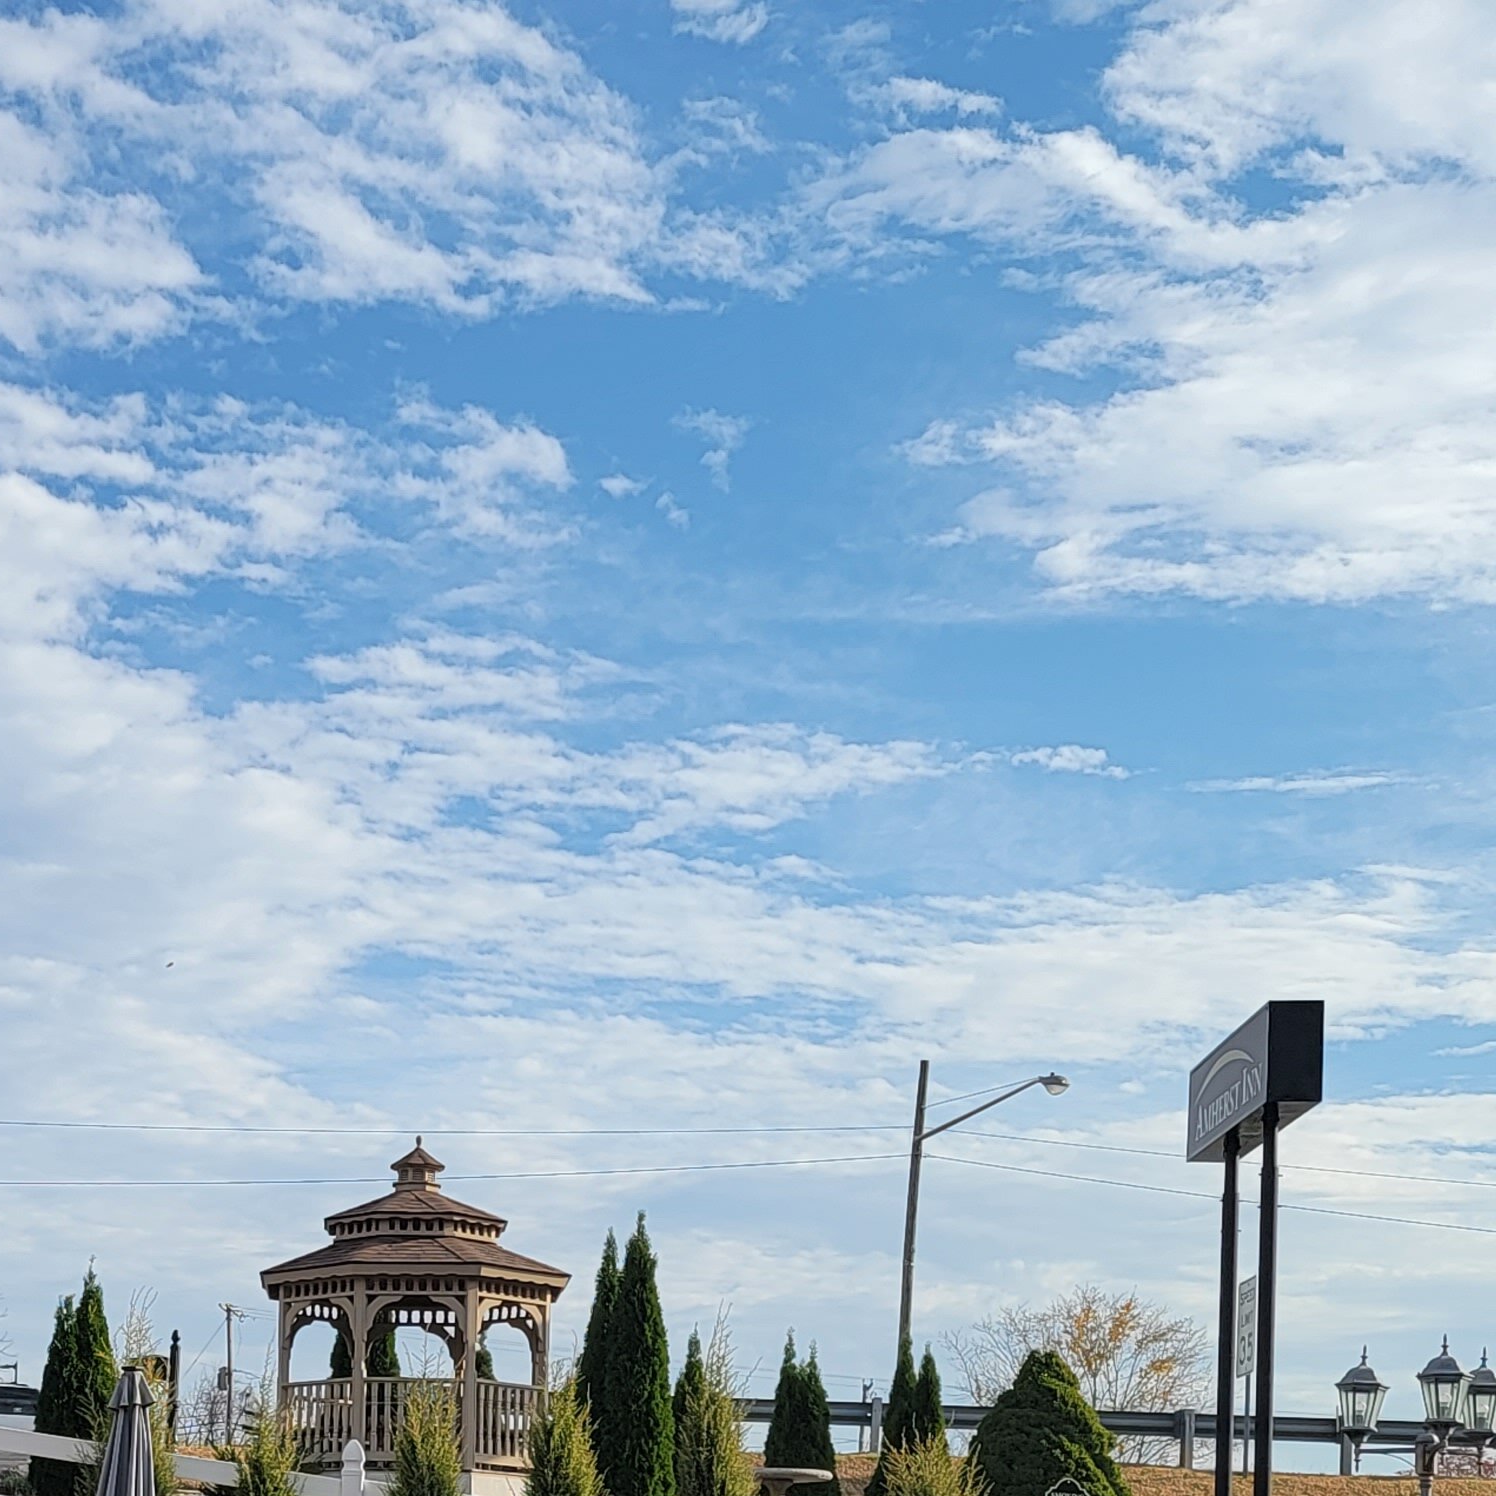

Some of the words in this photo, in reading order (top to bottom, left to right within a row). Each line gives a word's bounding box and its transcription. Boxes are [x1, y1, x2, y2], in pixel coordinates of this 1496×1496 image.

[1195, 1080, 1242, 1142] AMHERST
[1241, 1062, 1263, 1106] INN
[1239, 1331, 1253, 1366] 35
